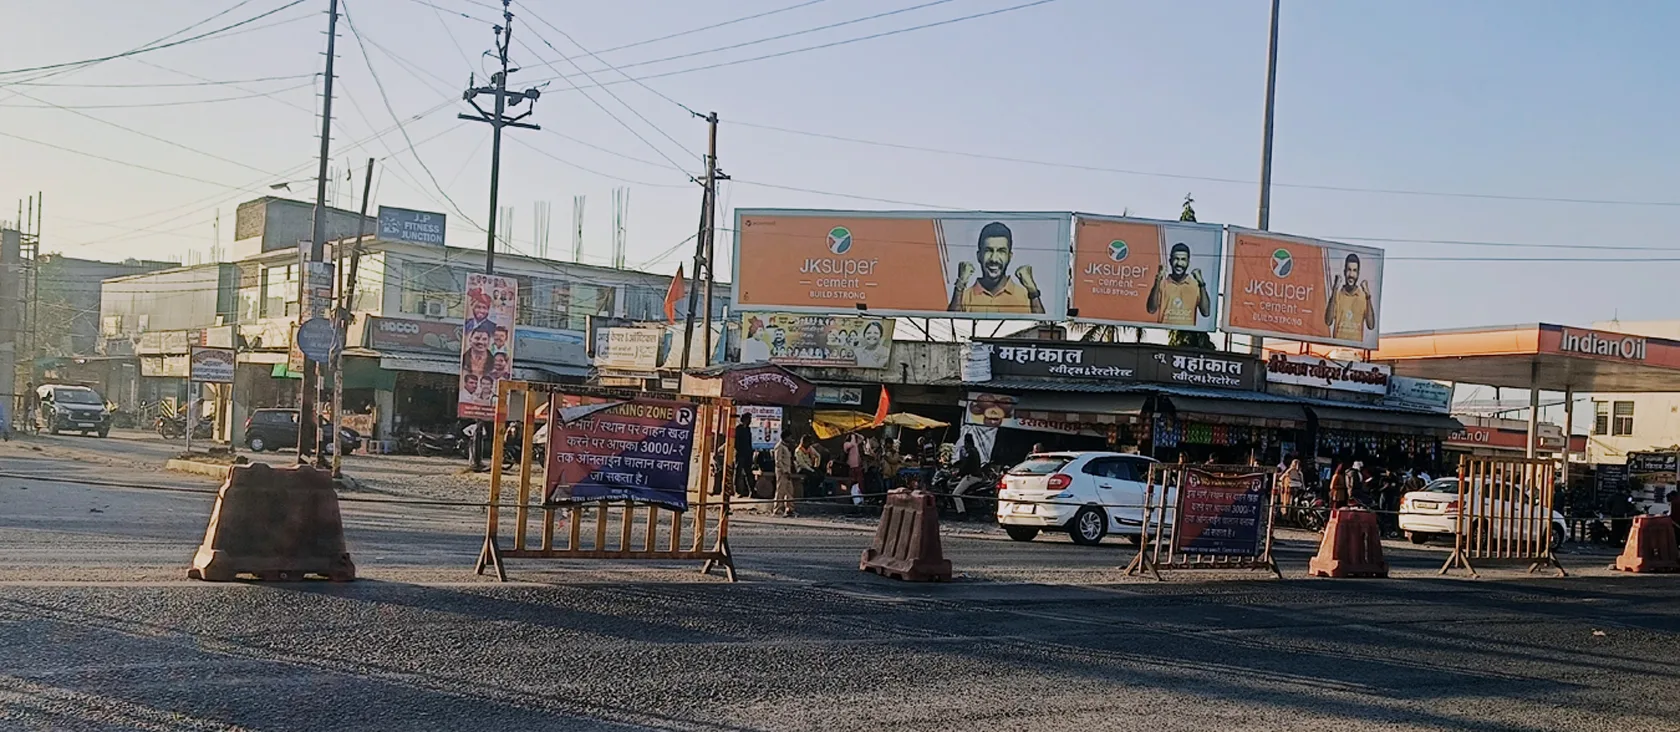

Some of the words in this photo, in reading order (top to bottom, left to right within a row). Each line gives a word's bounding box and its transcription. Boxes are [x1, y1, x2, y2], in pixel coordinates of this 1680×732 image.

[404, 222, 440, 233] FITNESS
[401, 231, 442, 242] JUNCTION
[816, 277, 859, 288] cement
[1098, 278, 1134, 288] cement
[810, 290, 832, 299] BUILD
[834, 291, 866, 300] STRONG
[1112, 288, 1139, 297] STRONG
[1259, 300, 1298, 314] cement
[380, 321, 420, 334] HOCCO
[1561, 329, 1647, 360] IndianOil
[999, 344, 1084, 363] महांकाल
[1172, 355, 1243, 375] महांकाल
[646, 405, 673, 419] ZONE
[628, 423, 640, 435] पर
[641, 427, 666, 438] वाहन
[567, 434, 589, 448] करने
[591, 438, 605, 449] पर
[606, 439, 639, 452] आपका
[557, 451, 574, 464] तक
[575, 450, 621, 468] ऑनलाईन
[624, 456, 654, 469] चालान
[605, 470, 634, 483] सकता
